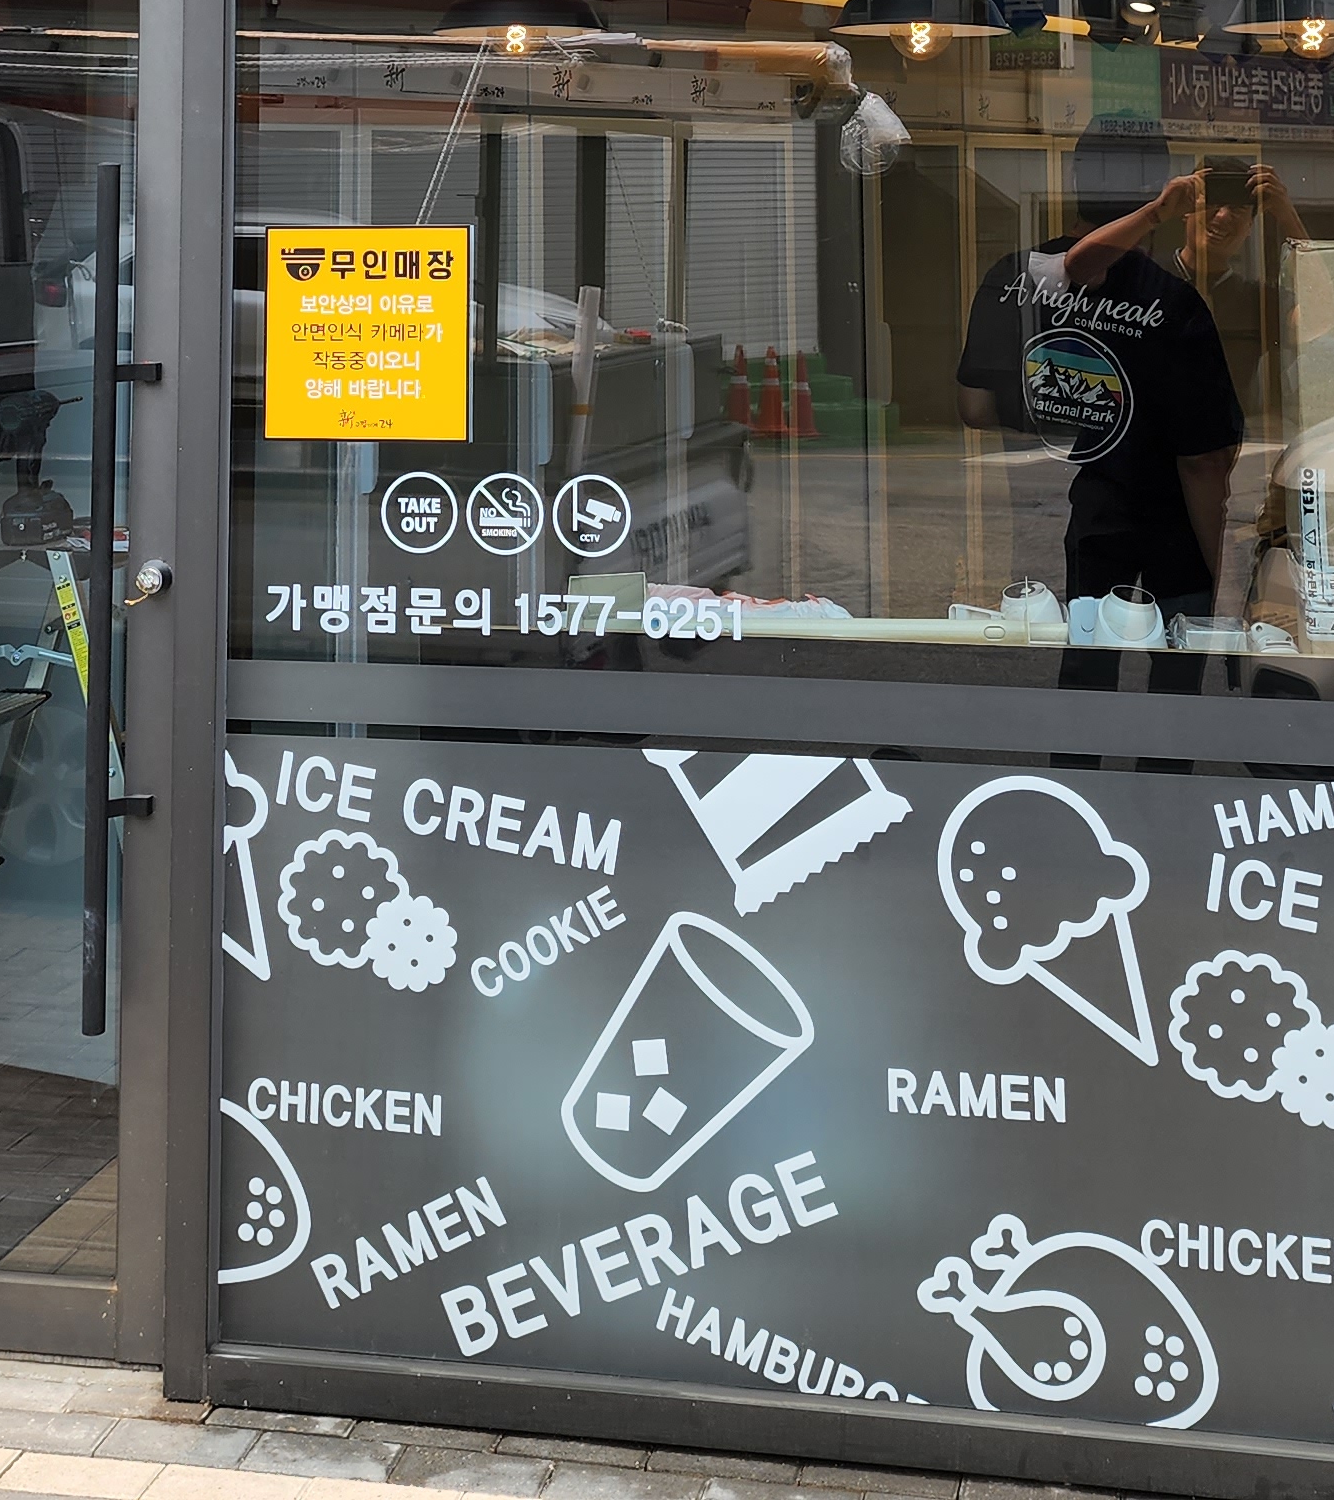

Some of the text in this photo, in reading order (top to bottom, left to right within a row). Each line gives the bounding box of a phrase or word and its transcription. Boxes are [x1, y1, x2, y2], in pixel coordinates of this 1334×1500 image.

[330, 249, 455, 281] 무인매장
[299, 295, 435, 315] 보안상의 이유로
[999, 271, 1165, 331] A high peak
[290, 322, 444, 344] 안면인식 카메라가
[1073, 317, 1143, 339] CONQUEROR
[312, 350, 421, 371] 작동중이오니
[304, 379, 342, 400] 양해
[1082, 408, 1116, 424] Park
[397, 497, 442, 515] TAKE
[479, 507, 497, 518] NO
[400, 517, 438, 535] OUT
[481, 528, 518, 538] SMOKING
[579, 533, 601, 543] CCTV
[266, 583, 744, 641] 가맹점문의 1577-6251
[275, 750, 622, 875] ICE CREAM
[1205, 853, 1324, 933] ICE
[470, 885, 627, 998] COOKIE
[887, 1067, 1067, 1124] RAMEN
[246, 1077, 442, 1137] CHICKEN
[310, 1176, 507, 1310] RAMEN
[440, 1150, 839, 1358] BEVERAGE
